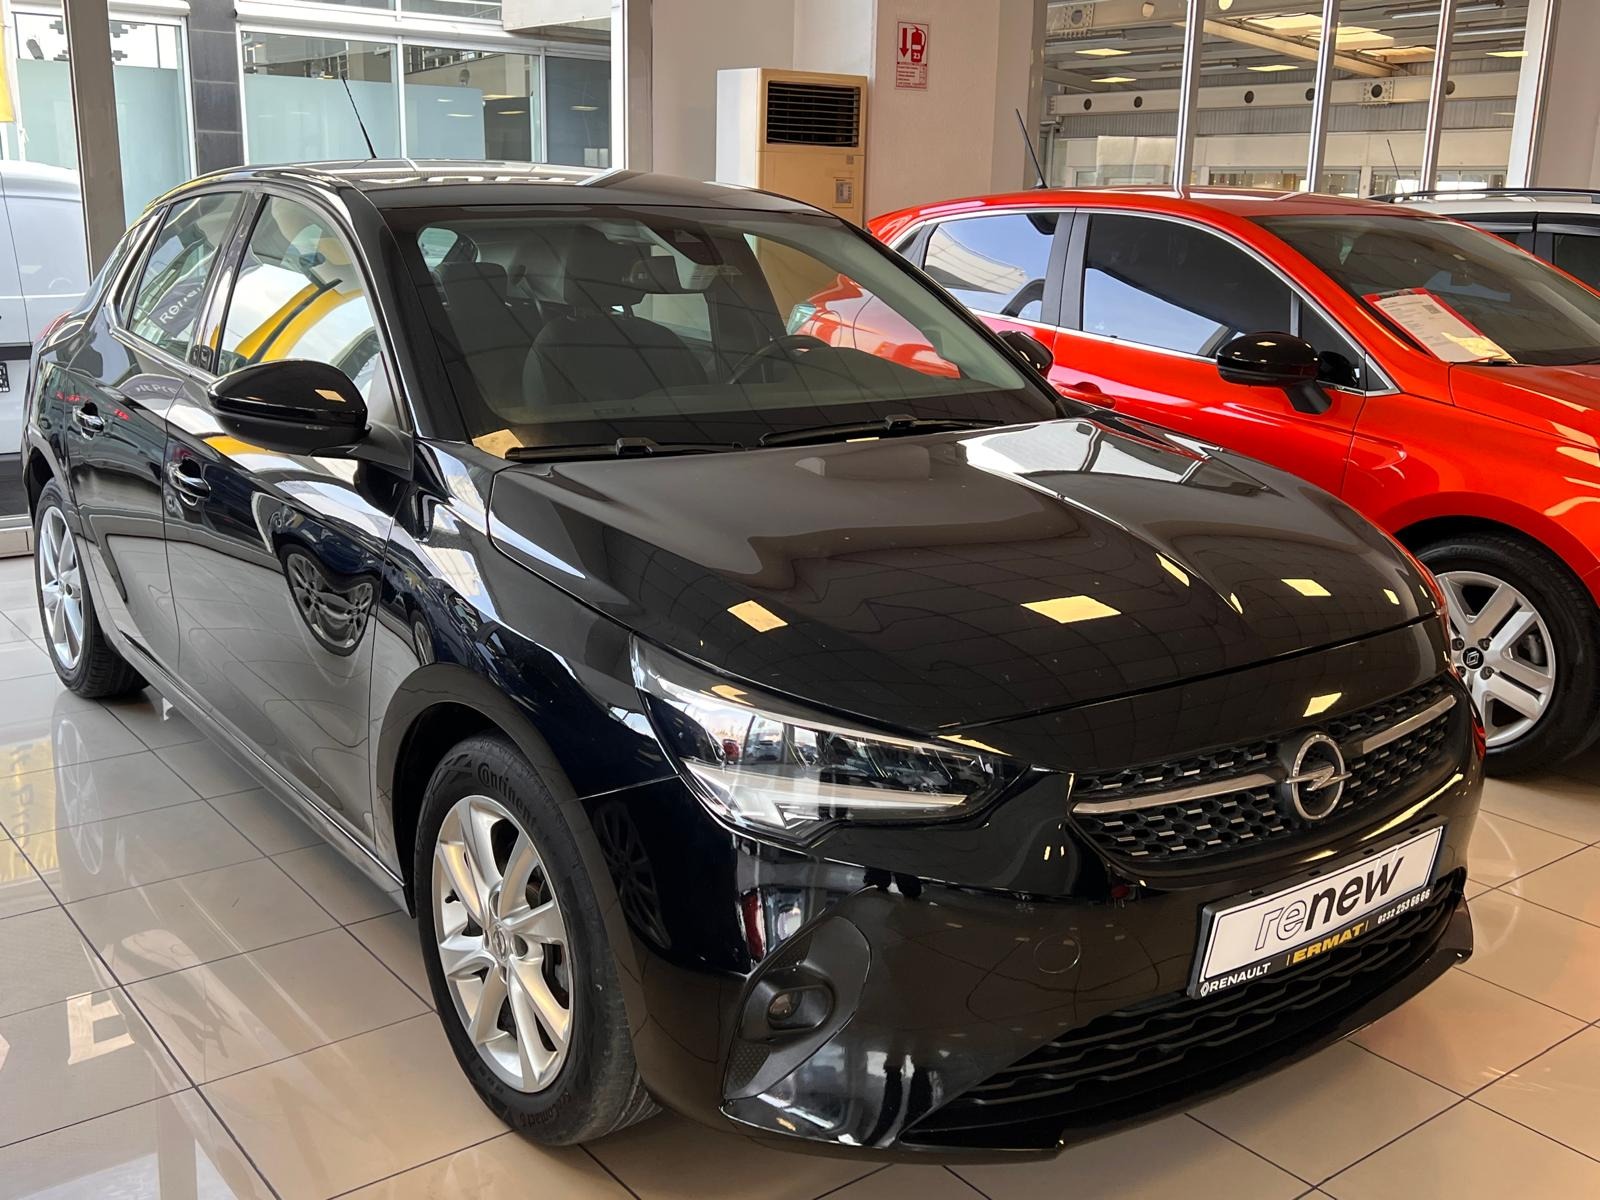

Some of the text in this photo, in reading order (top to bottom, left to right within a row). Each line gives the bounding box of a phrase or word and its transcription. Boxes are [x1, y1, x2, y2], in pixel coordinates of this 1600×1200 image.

[1255, 856, 1404, 950] renew
[1209, 962, 1272, 993] RENAULT
[1292, 922, 1365, 963] ERMAT
